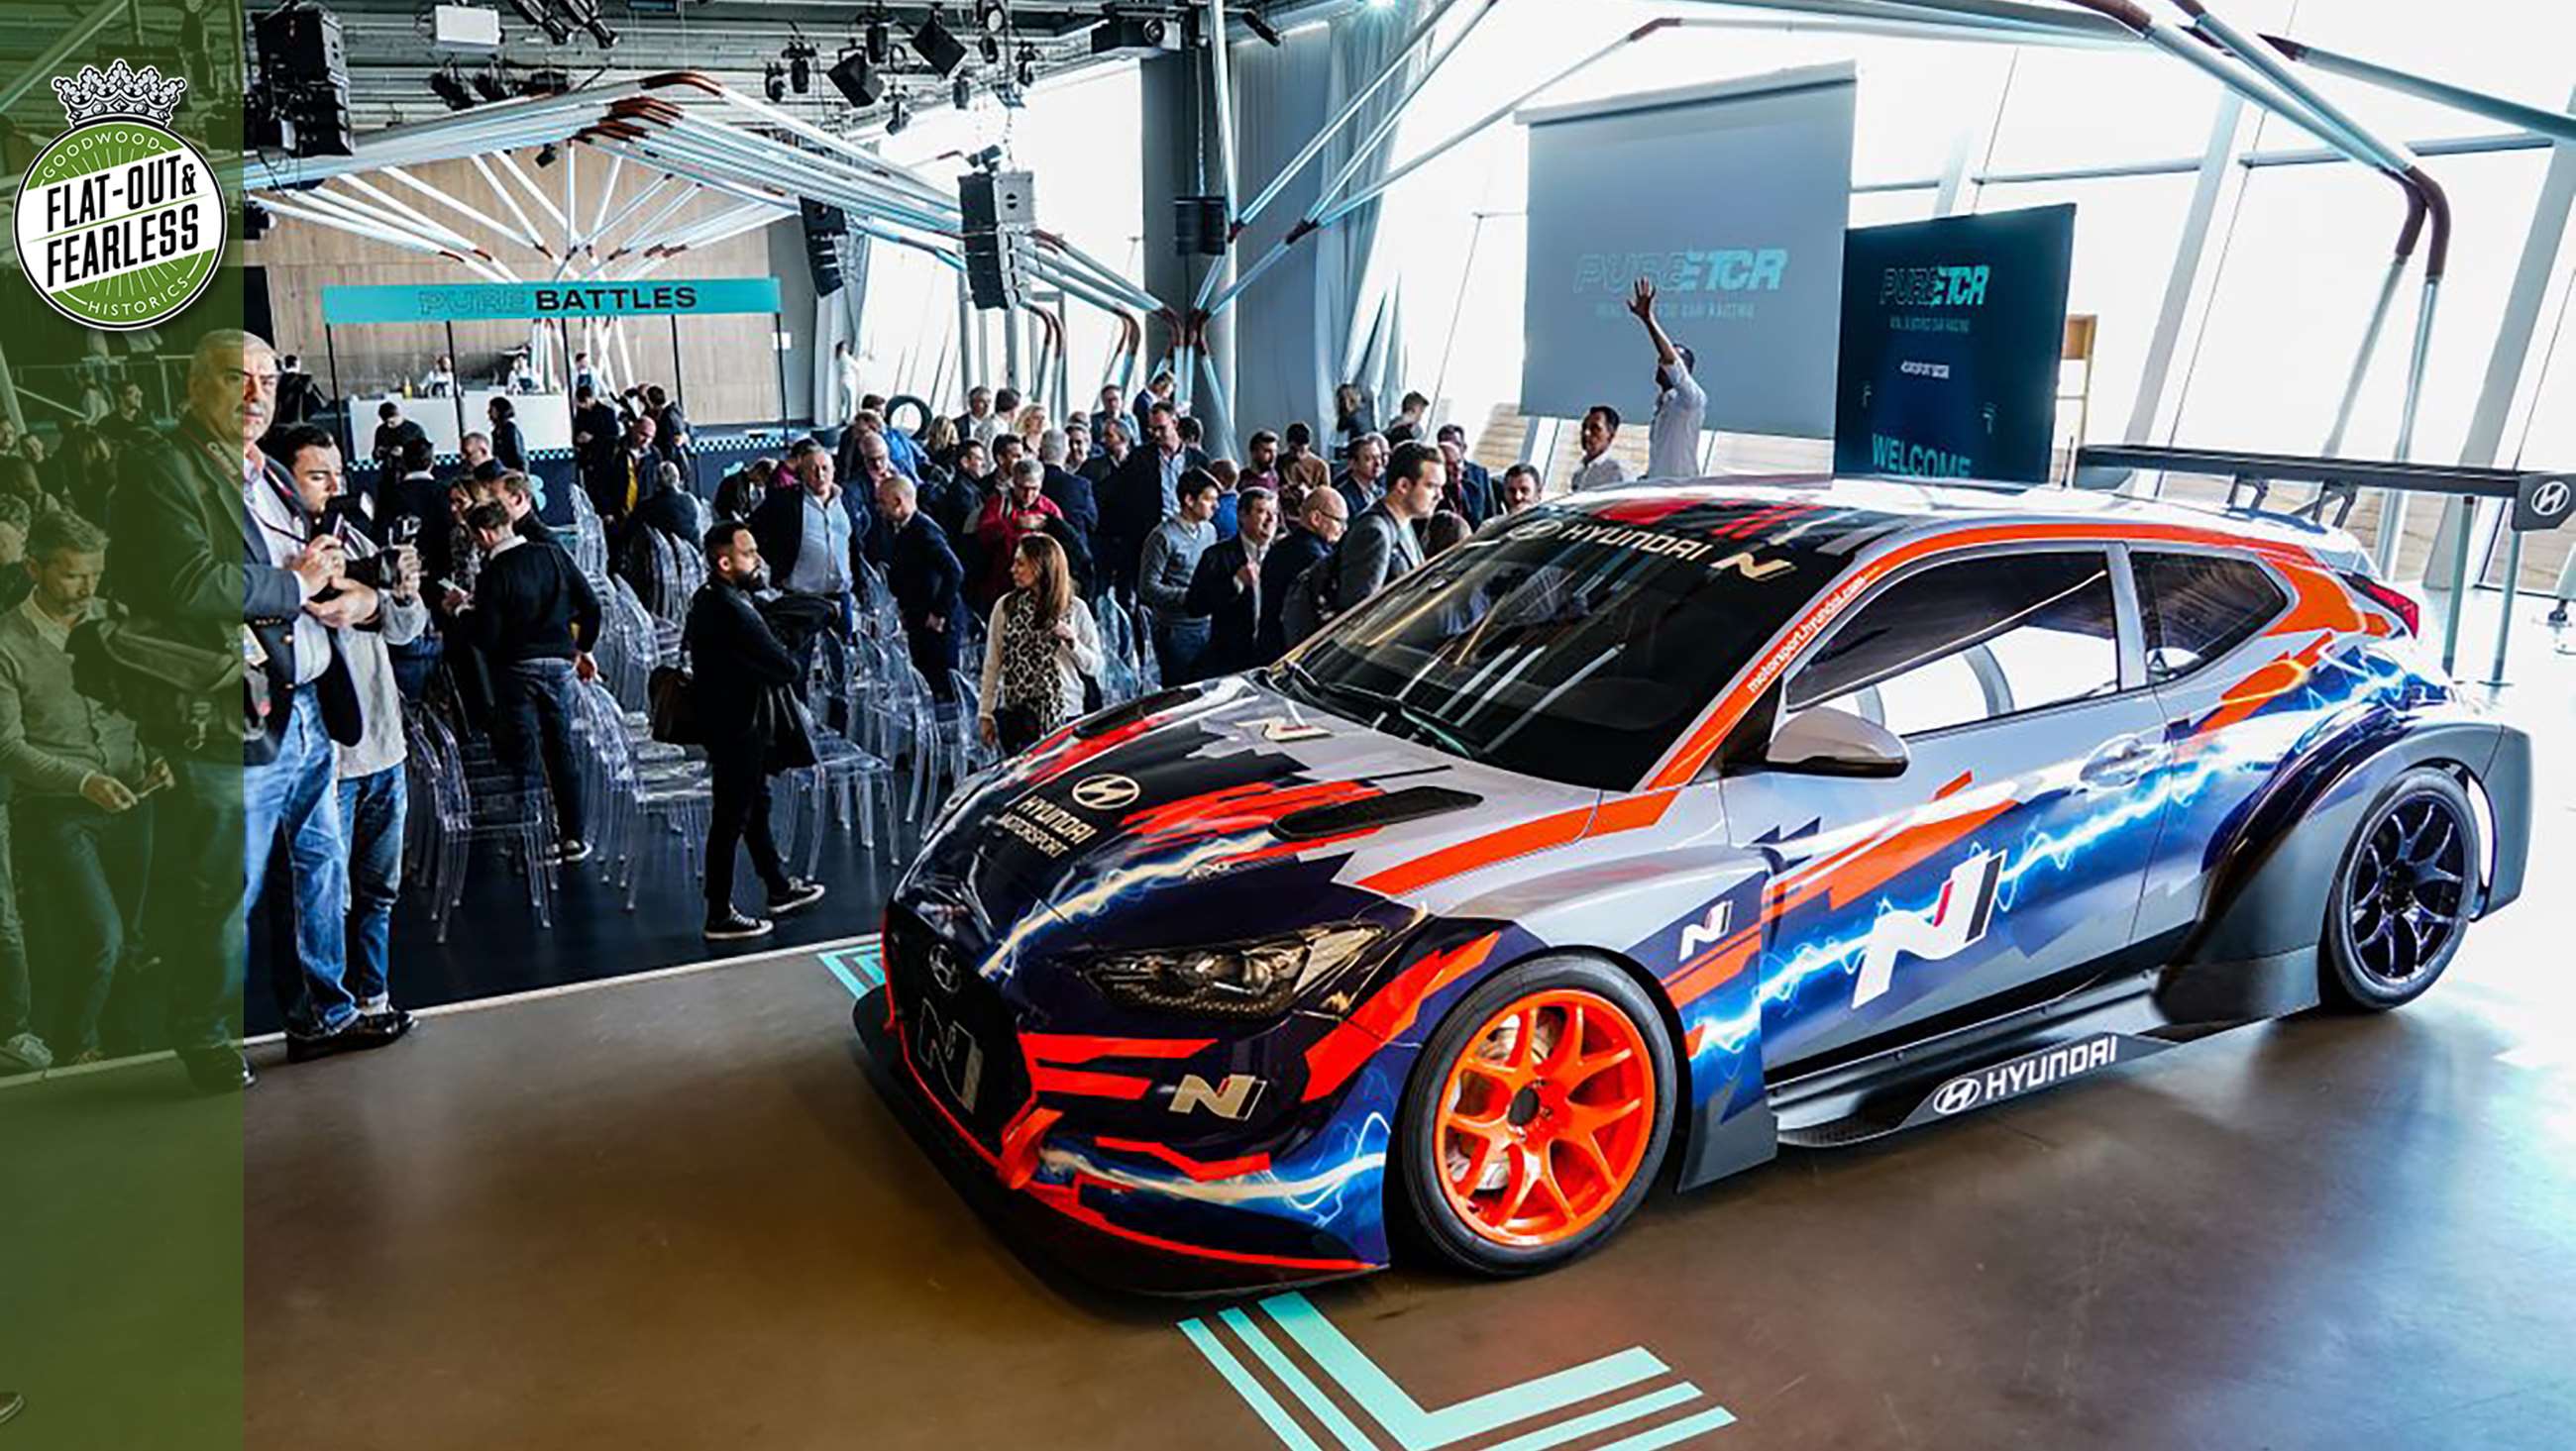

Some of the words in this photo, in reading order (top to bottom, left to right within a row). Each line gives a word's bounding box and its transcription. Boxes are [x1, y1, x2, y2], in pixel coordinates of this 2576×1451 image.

[535, 287, 698, 310] BATTLES
[1872, 433, 1972, 477] WELCOME
[1558, 524, 1713, 561] HYUNDAI
[997, 811, 1070, 858] MOTORSPORT
[1017, 795, 1098, 845] HYUNDAI
[1986, 1035, 2117, 1099] HYUNDAI
